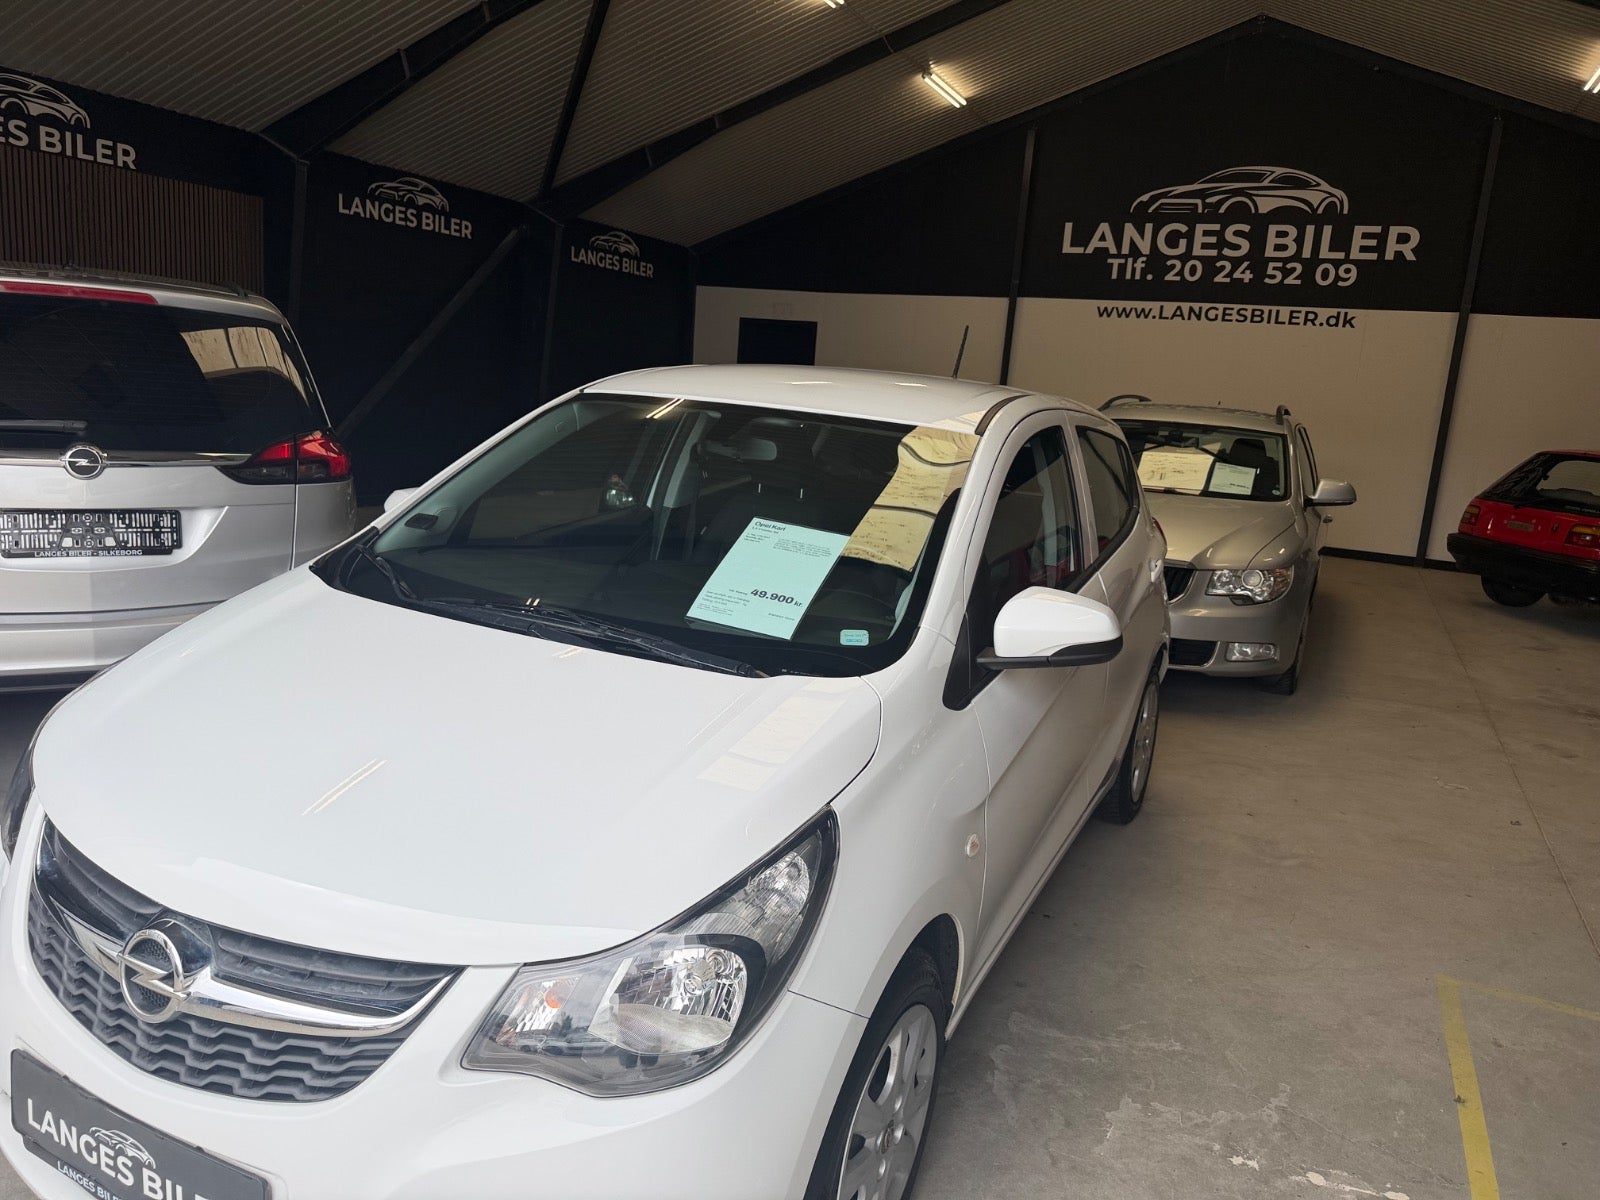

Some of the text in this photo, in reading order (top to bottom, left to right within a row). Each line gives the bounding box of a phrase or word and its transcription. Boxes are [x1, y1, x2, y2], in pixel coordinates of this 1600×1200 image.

[39, 126, 136, 169] BILER
[338, 193, 472, 240] LANGES BILER
[1061, 221, 1420, 261] LANGES BILER
[570, 246, 654, 278] LANGES BILER
[1107, 257, 1358, 287] Tlf. 20 24 52 09
[1096, 304, 1356, 329] www.LANGESBILER.dk
[751, 588, 794, 604] 49.900
[27, 1098, 209, 1200] LANGES BIL
[57, 1160, 96, 1193] LANGES
